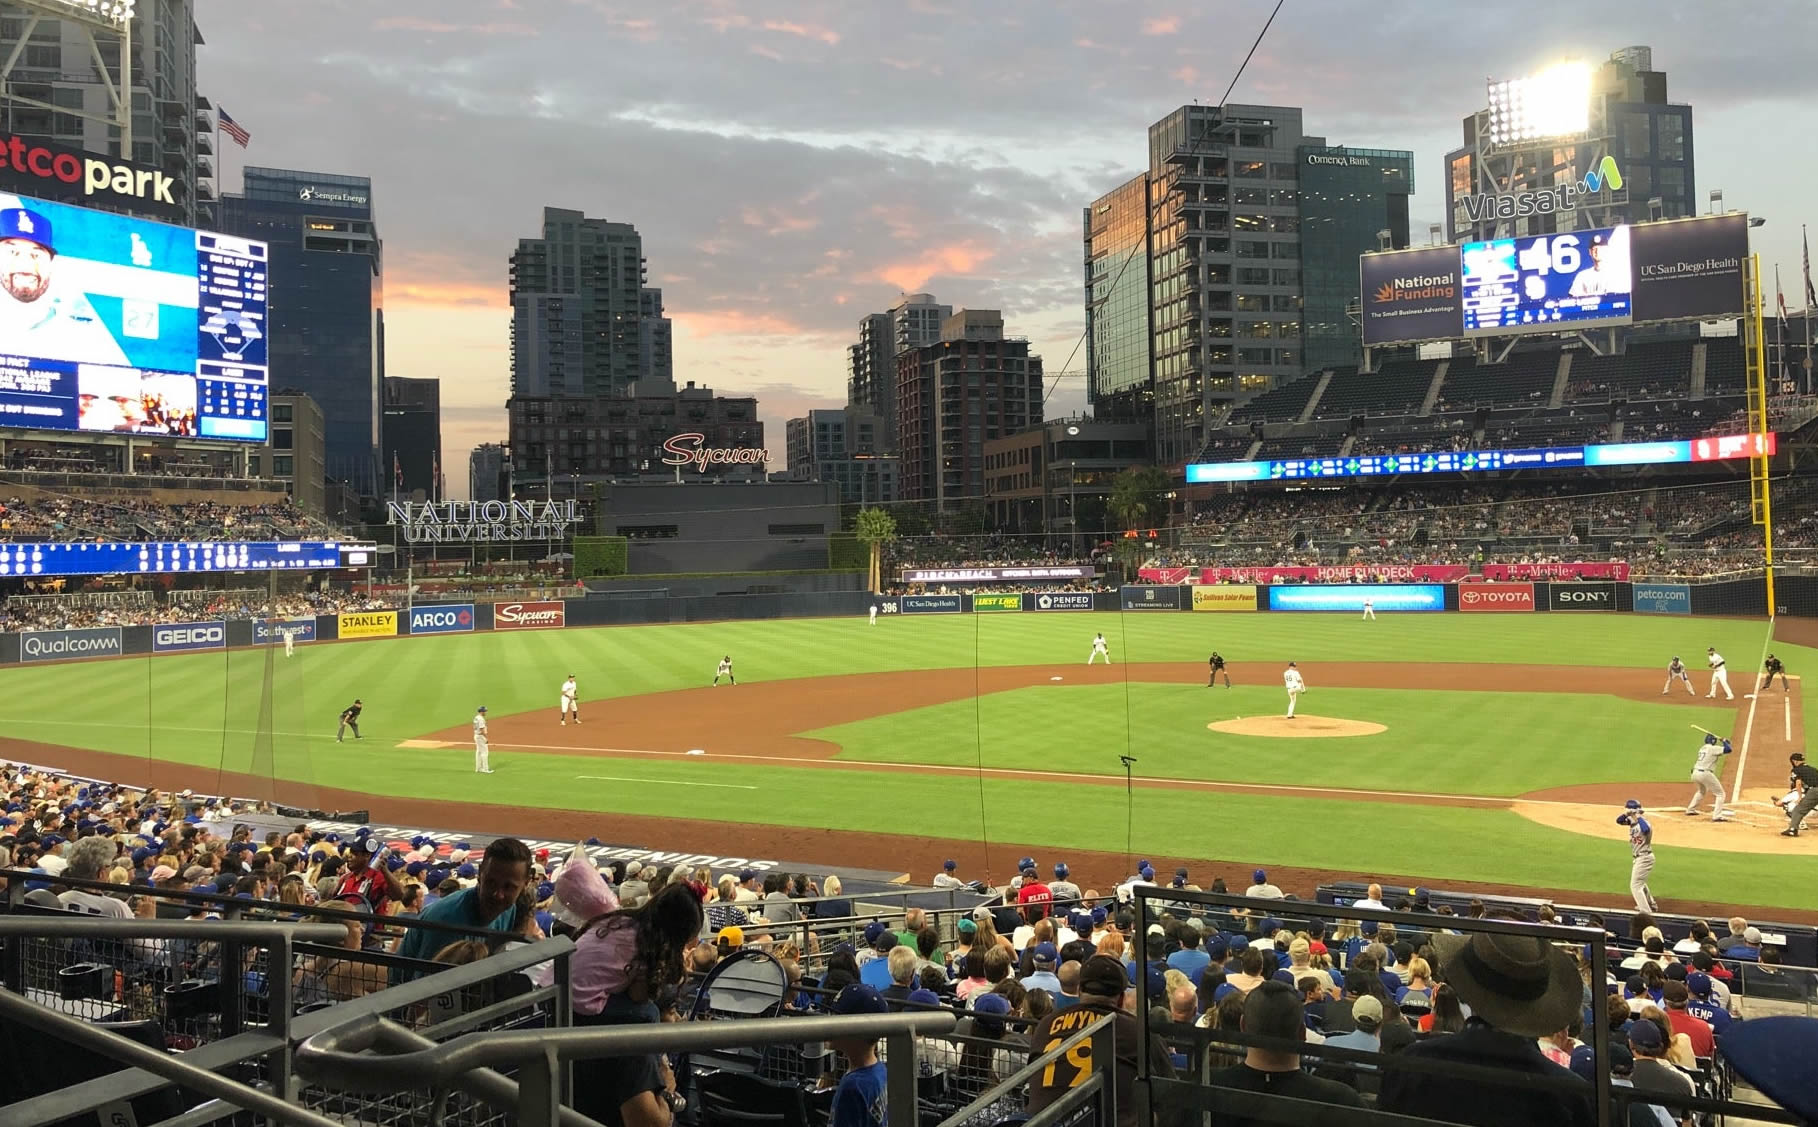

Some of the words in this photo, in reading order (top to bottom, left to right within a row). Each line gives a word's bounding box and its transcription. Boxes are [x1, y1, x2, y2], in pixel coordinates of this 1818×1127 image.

[1349, 156, 1370, 166] Bank
[315, 191, 342, 201] Sempra
[342, 193, 367, 204] Energy
[1463, 183, 1575, 222] Viasat
[1519, 234, 1581, 276] 46
[1641, 264, 1657, 276] UC
[1657, 263, 1676, 275] San
[1677, 262, 1705, 273] Diego
[1706, 257, 1738, 270] Health
[1394, 272, 1454, 290] National
[1394, 285, 1454, 301] Funding
[1399, 308, 1423, 316] Business
[1424, 305, 1455, 314] Advantage
[662, 433, 774, 473] Sycuan
[386, 499, 584, 525] NATIONAL
[403, 522, 569, 543] UNIVERSITY
[1318, 567, 1353, 579] HOME
[1382, 566, 1415, 578] DECK
[1053, 596, 1089, 604] PENFED
[1203, 593, 1225, 601] Sullivan
[1225, 593, 1239, 601] Solar
[1239, 593, 1255, 601] Power
[1481, 592, 1531, 602] TOYOTA
[1559, 591, 1609, 602] SONY
[1637, 589, 1685, 601] petco.com
[502, 604, 558, 625] Sycuan
[882, 602, 898, 613] 396
[342, 615, 392, 628] STANLEY
[412, 612, 456, 628] ARCO
[156, 627, 223, 646] GEICO
[25, 635, 119, 656] Qualcomm
[1028, 893, 1049, 903] ELITE
[1687, 1007, 1713, 1020] KEMP
[1049, 1010, 1104, 1036] GWYN
[1043, 1036, 1092, 1088] 19
